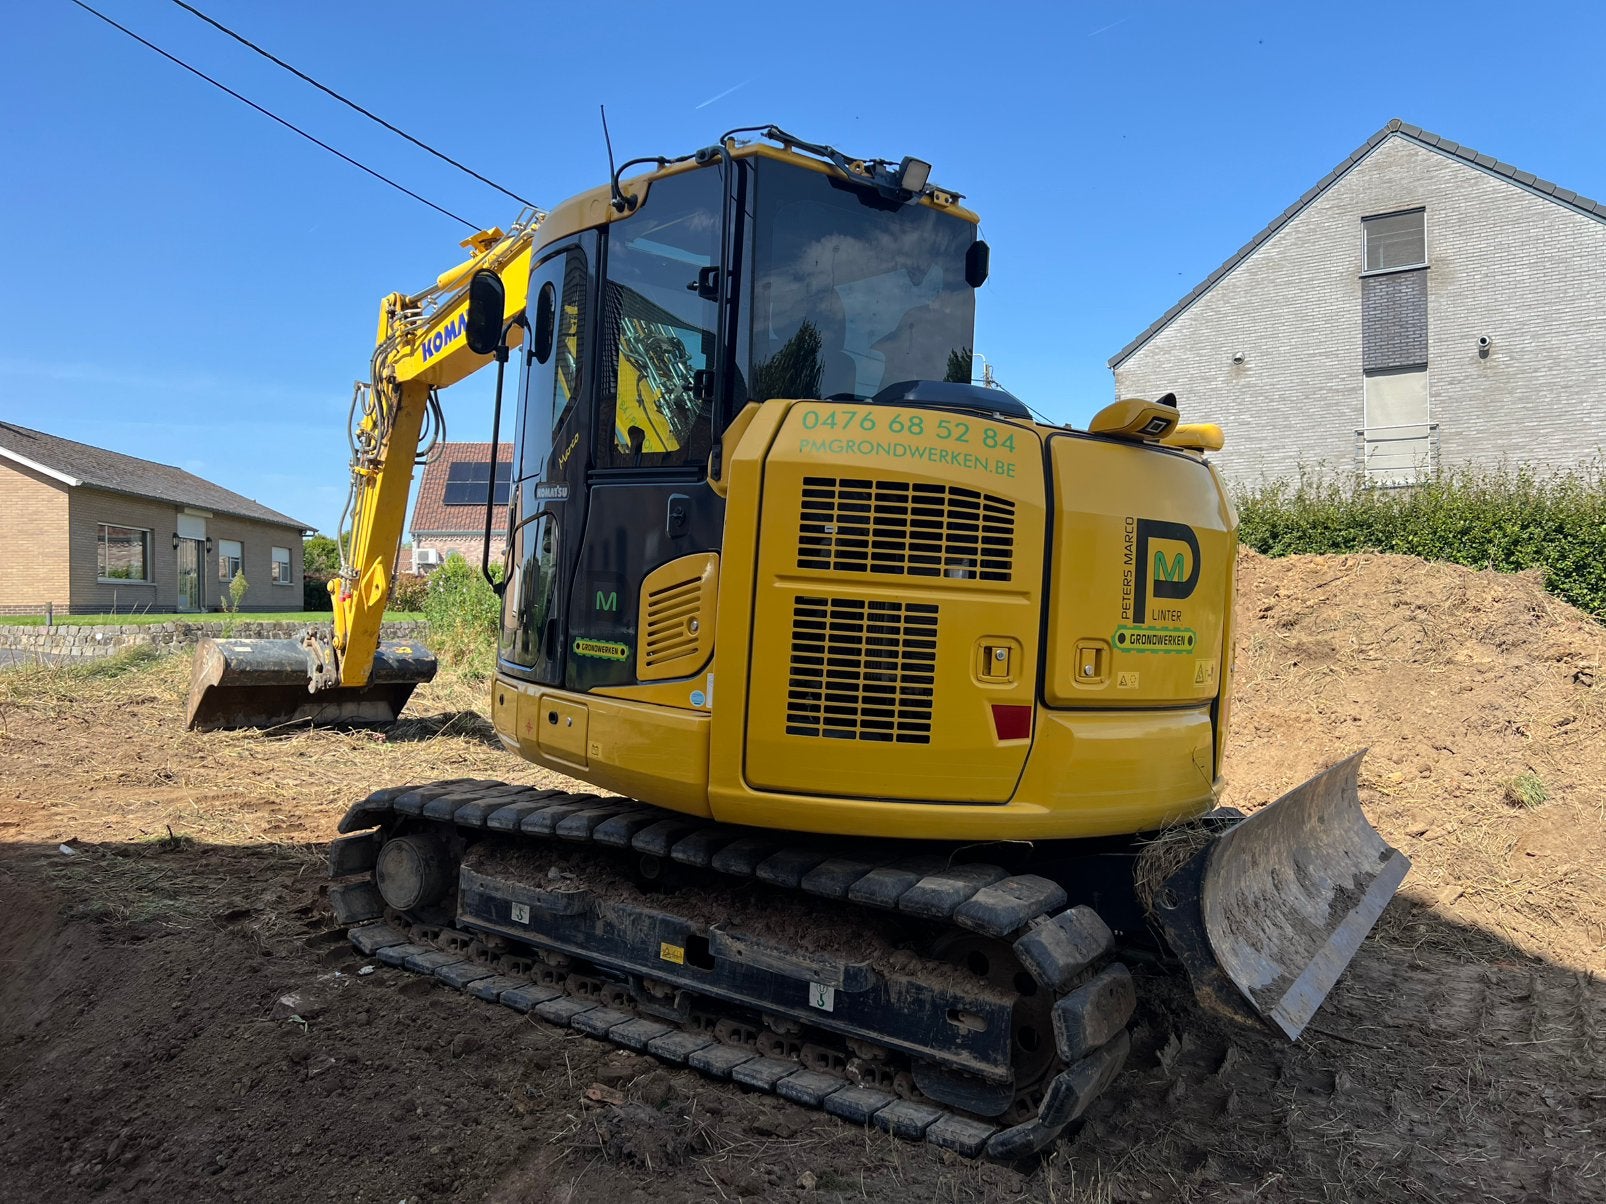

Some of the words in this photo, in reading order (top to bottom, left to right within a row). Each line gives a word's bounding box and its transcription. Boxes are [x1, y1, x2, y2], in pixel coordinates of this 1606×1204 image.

[421, 309, 469, 362] KOMA
[802, 410, 876, 432] 0476
[888, 413, 924, 435] 68
[936, 419, 970, 443] 52
[983, 428, 1016, 453] 84
[799, 439, 1016, 479] PMGRONDWERKEN.BE
[536, 485, 568, 498] KOMATSU
[1123, 516, 1134, 565] MARCO
[1121, 569, 1133, 620] PETERS
[1152, 609, 1182, 622] LINTER
[581, 643, 619, 655] GRONDWERKEN
[1129, 633, 1186, 646] GRONDWERKEN
